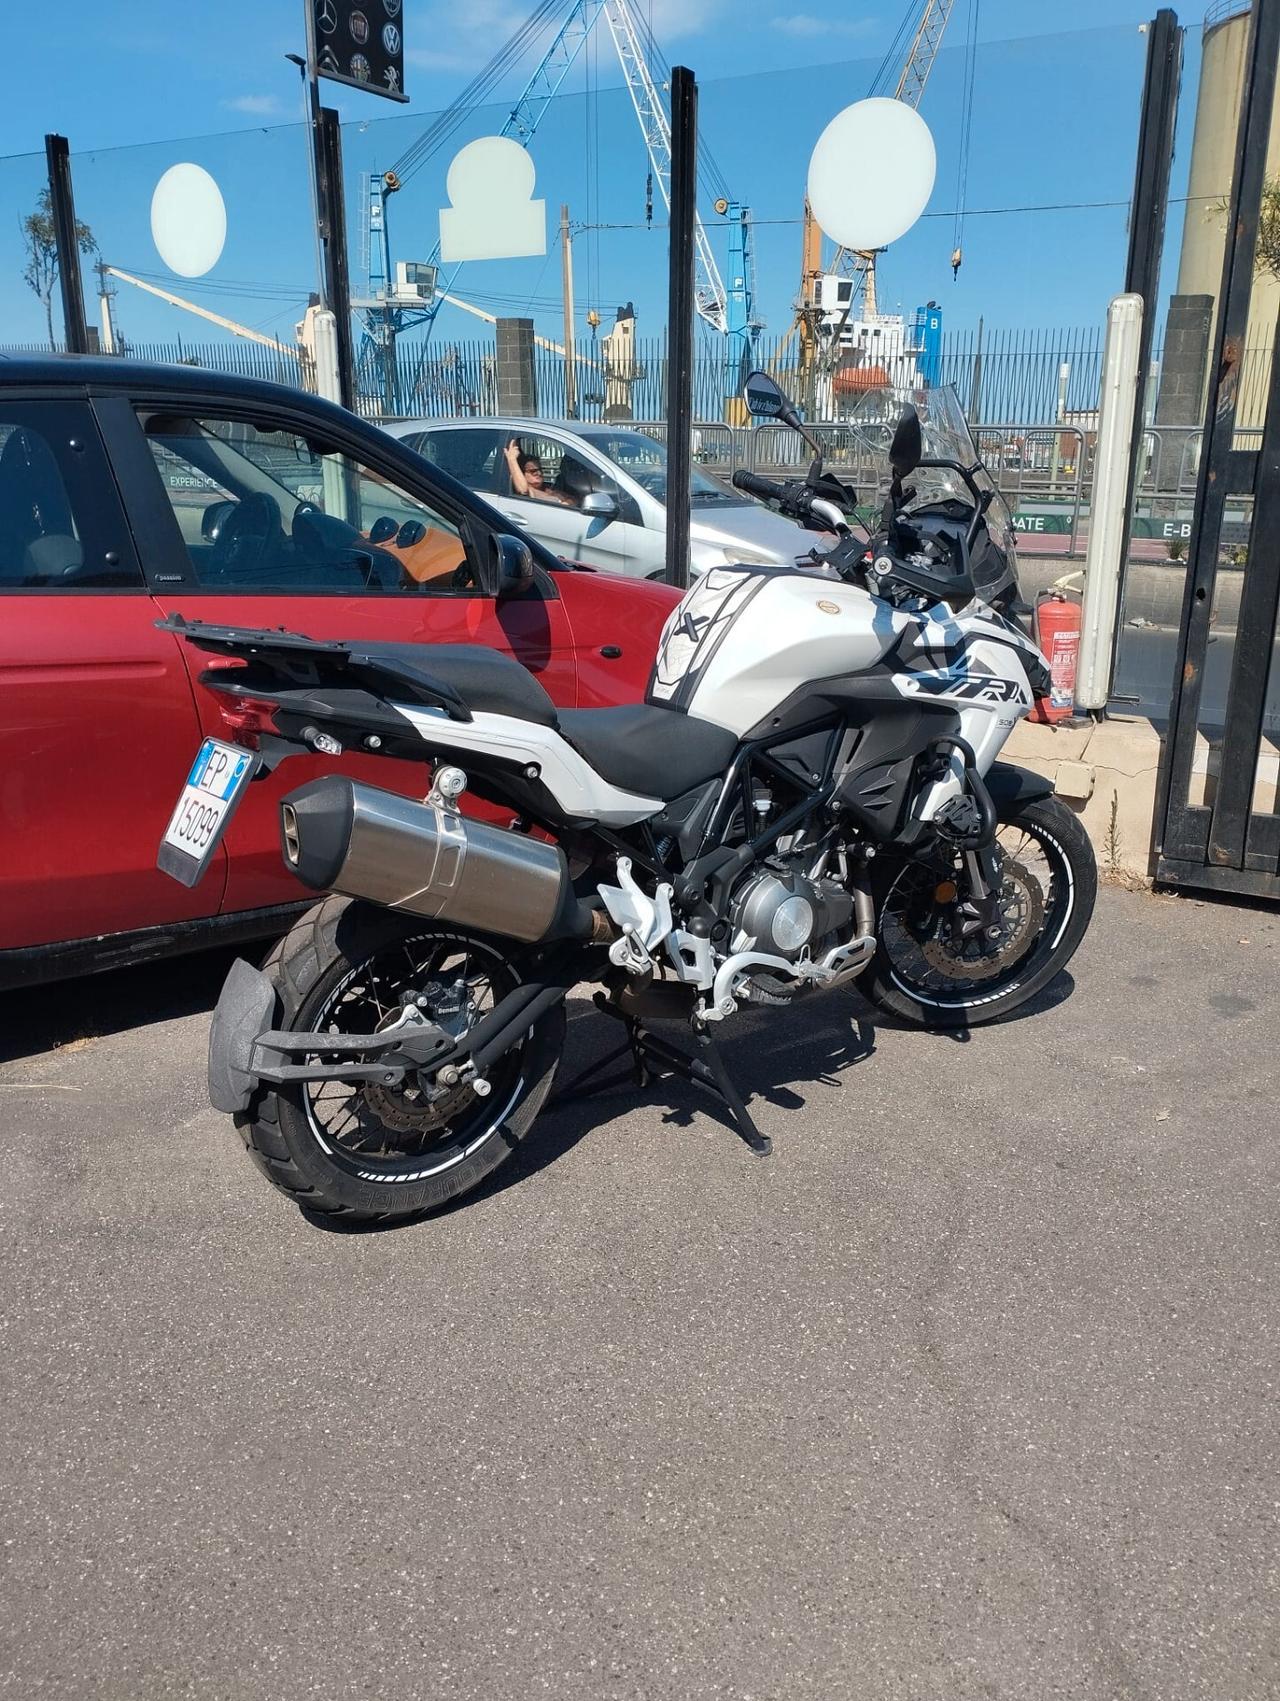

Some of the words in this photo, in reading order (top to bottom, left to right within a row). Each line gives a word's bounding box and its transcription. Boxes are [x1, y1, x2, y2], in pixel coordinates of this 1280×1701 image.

[930, 318, 938, 329] B
[170, 476, 218, 488] EXPERIENCE
[200, 749, 228, 788] EP
[173, 796, 219, 848] 15099
